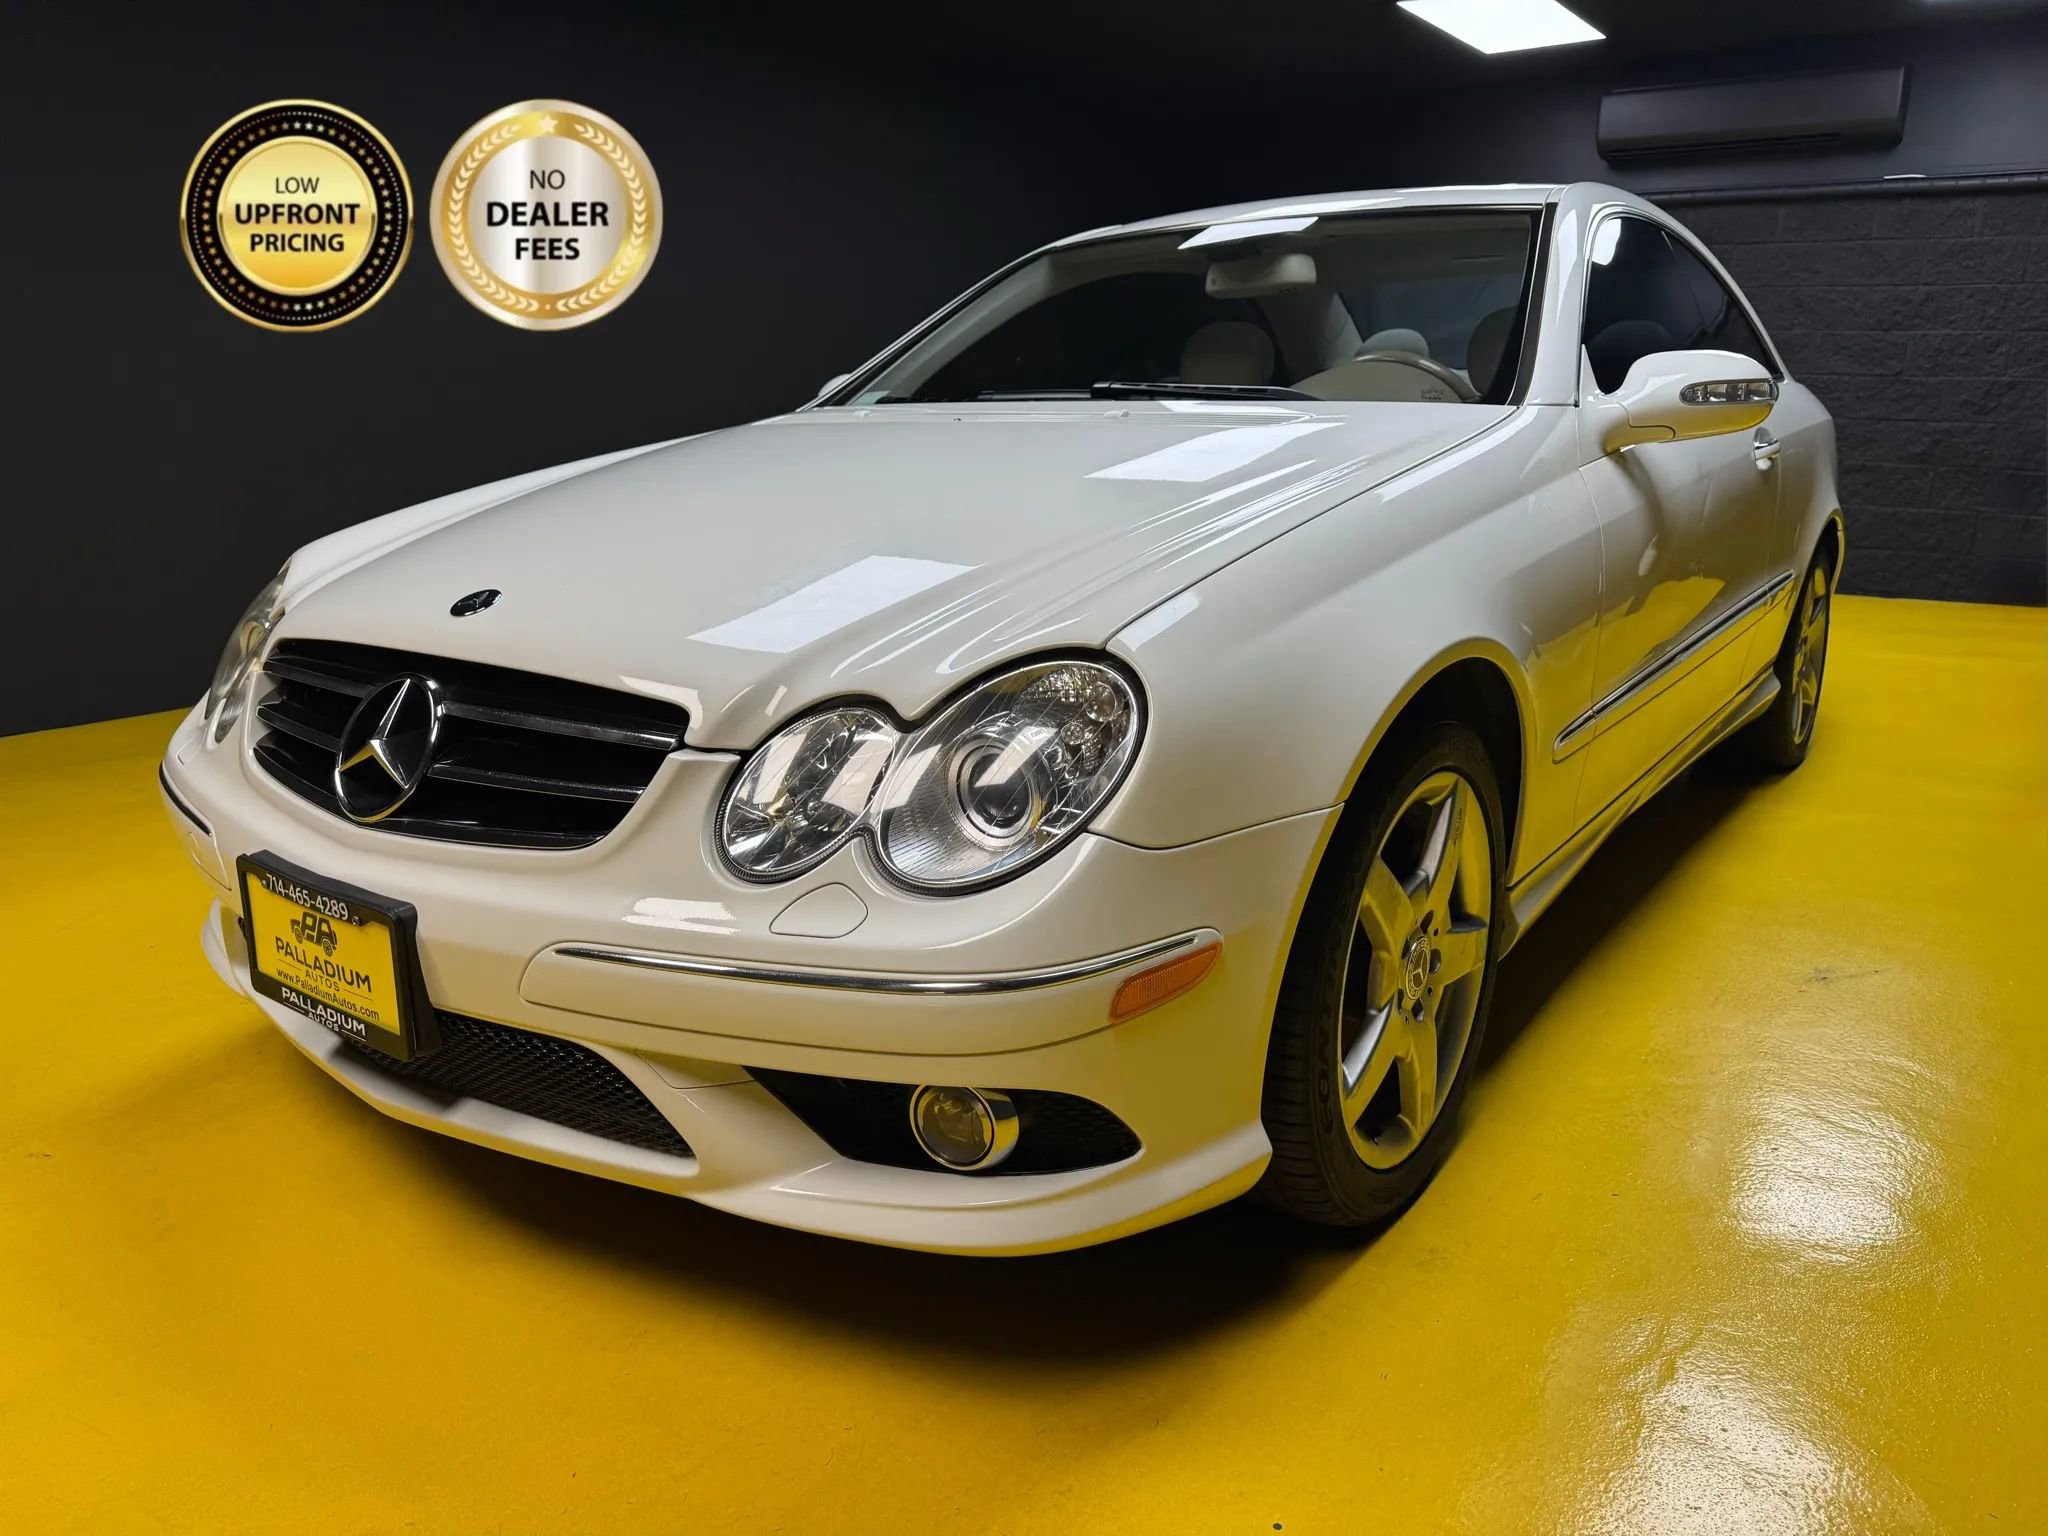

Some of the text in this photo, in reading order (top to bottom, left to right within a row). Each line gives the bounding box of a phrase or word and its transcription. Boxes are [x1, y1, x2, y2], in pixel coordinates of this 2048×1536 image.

[266, 874, 348, 920] 714-465-4289
[275, 936, 372, 992] PALLADIUM
[306, 970, 340, 992] AUTOS
[276, 968, 379, 1021] www.PalladiumAutos.com
[282, 987, 365, 1036] PALLADIUM
[308, 1012, 339, 1031] AUTOS
